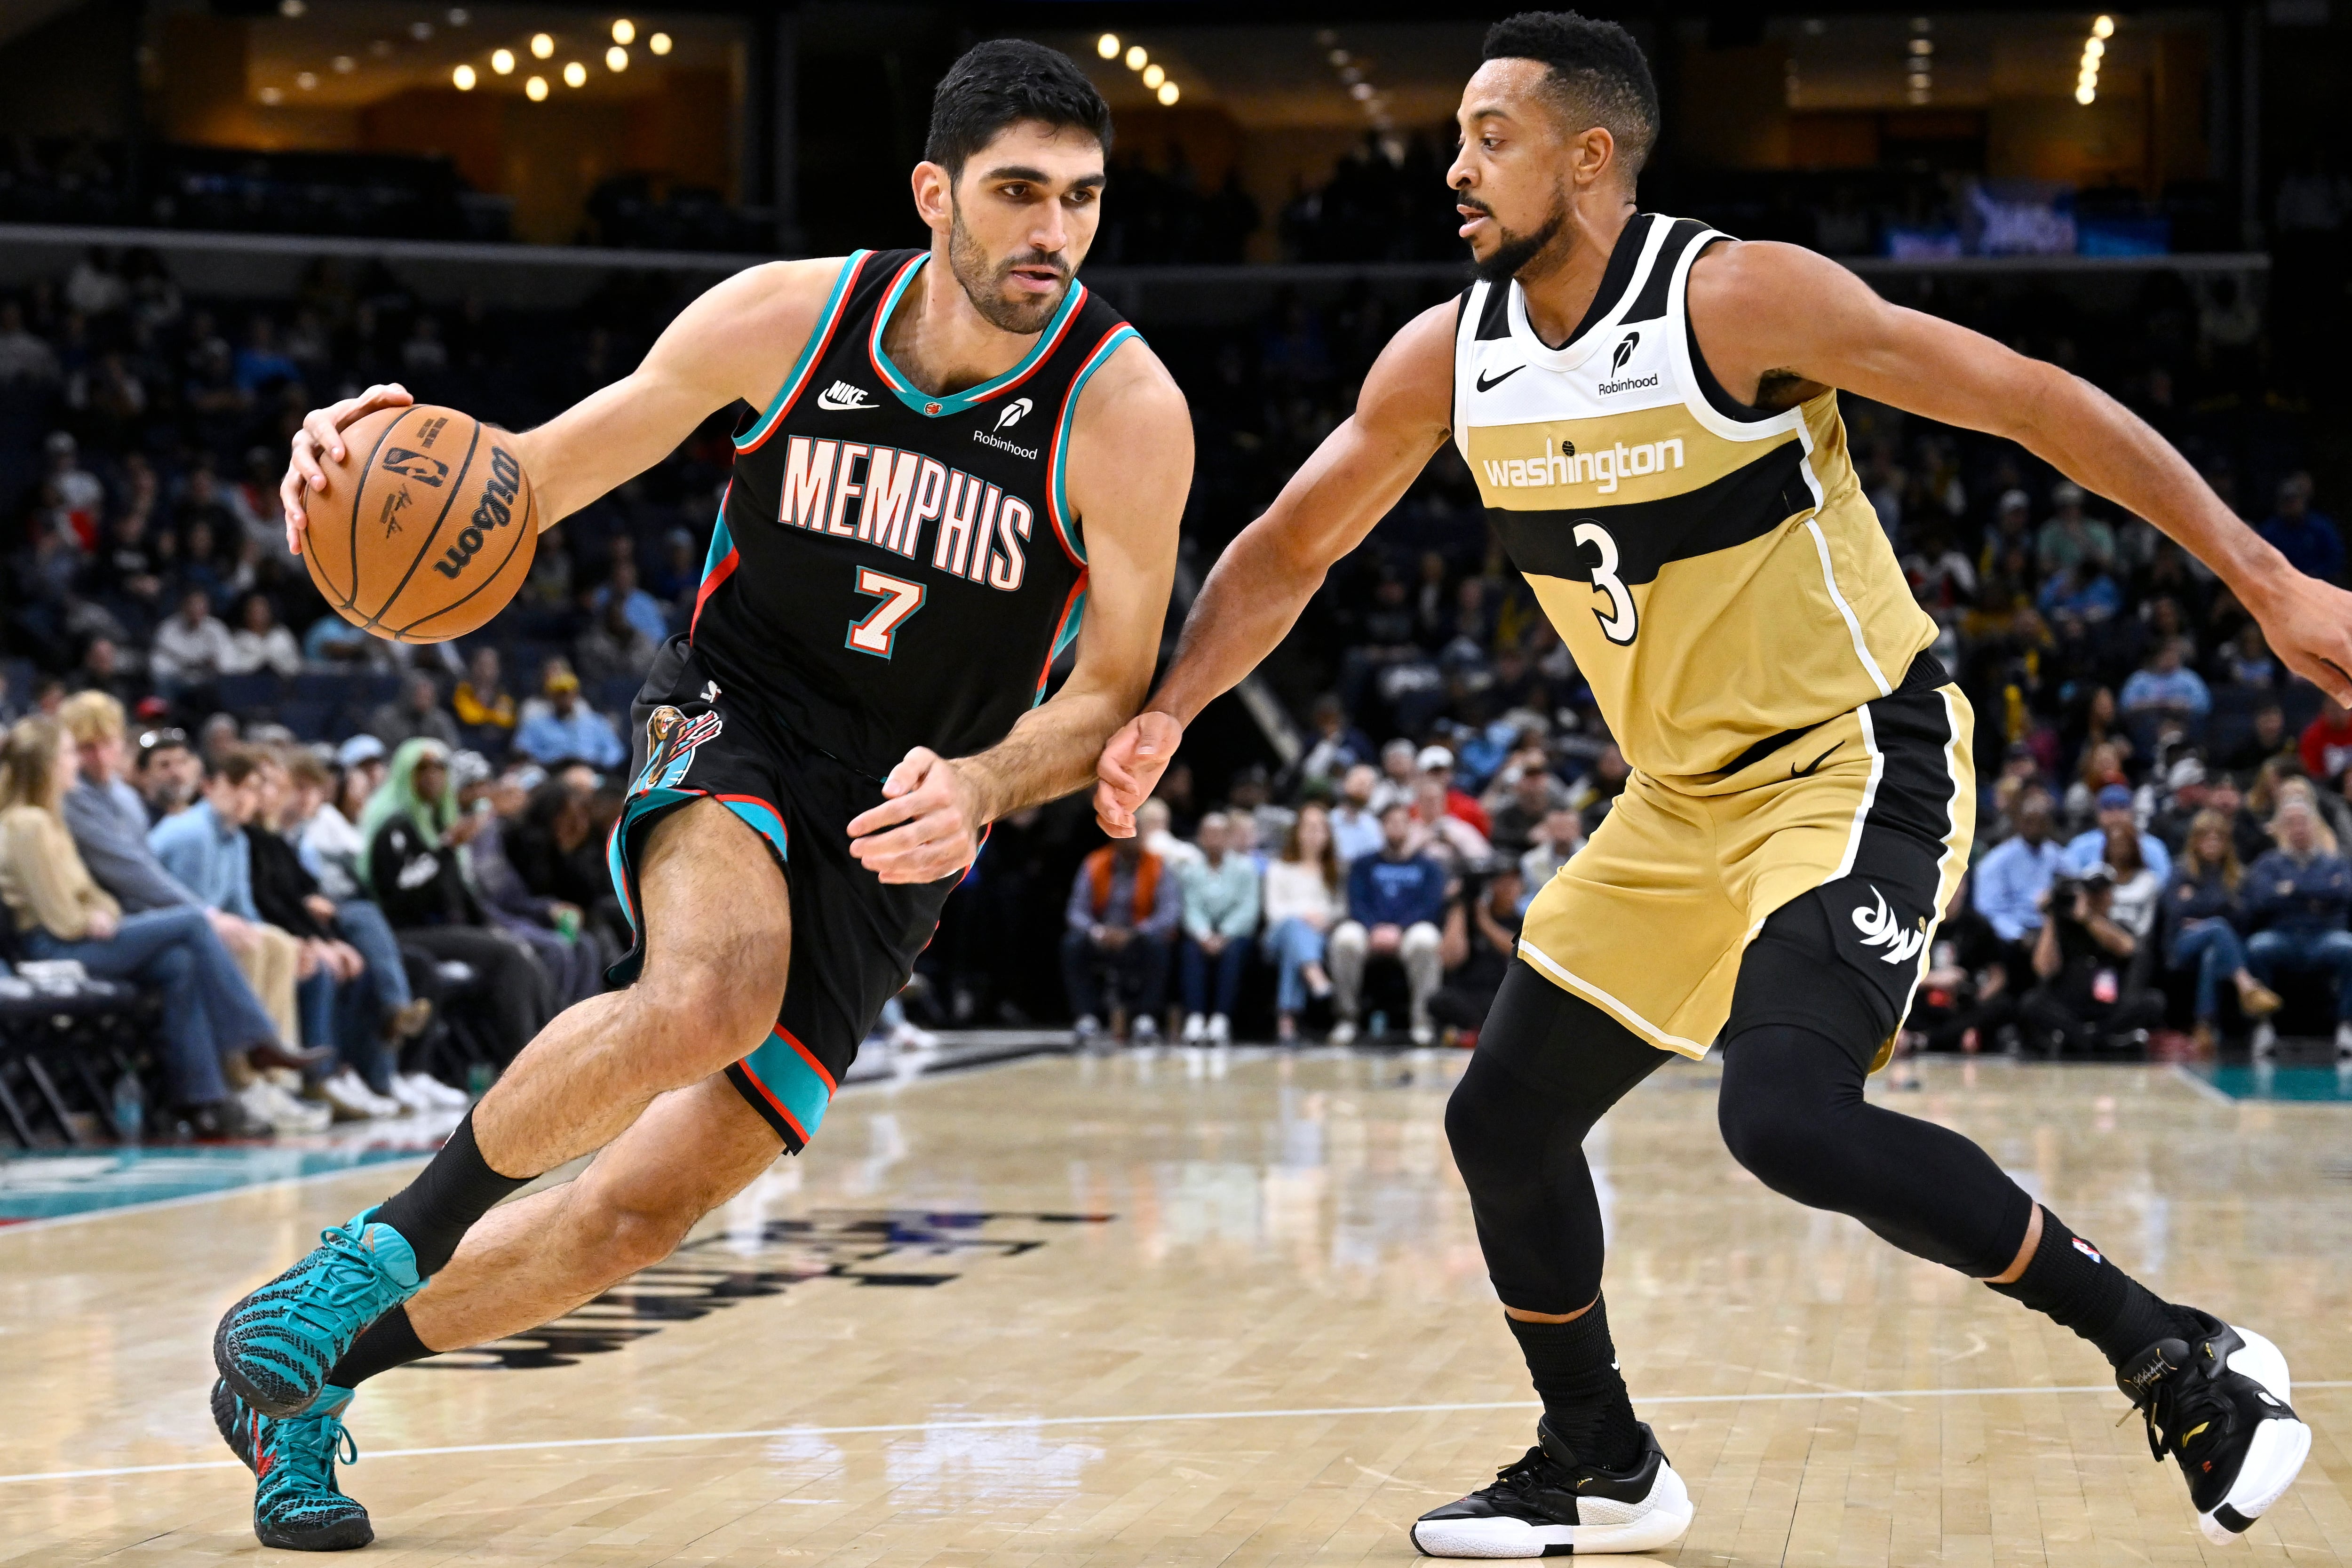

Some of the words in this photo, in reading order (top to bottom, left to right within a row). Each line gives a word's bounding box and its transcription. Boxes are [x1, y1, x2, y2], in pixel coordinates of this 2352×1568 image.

[826, 380, 868, 406] NIKE
[1598, 374, 1658, 395] Robinhood
[974, 430, 1038, 459] Robinhood
[1483, 435, 1685, 493] washington
[432, 446, 519, 579] Wilson
[778, 435, 1034, 591] MEMPHIS
[844, 565, 927, 658] 7
[1572, 521, 1638, 647] 3
